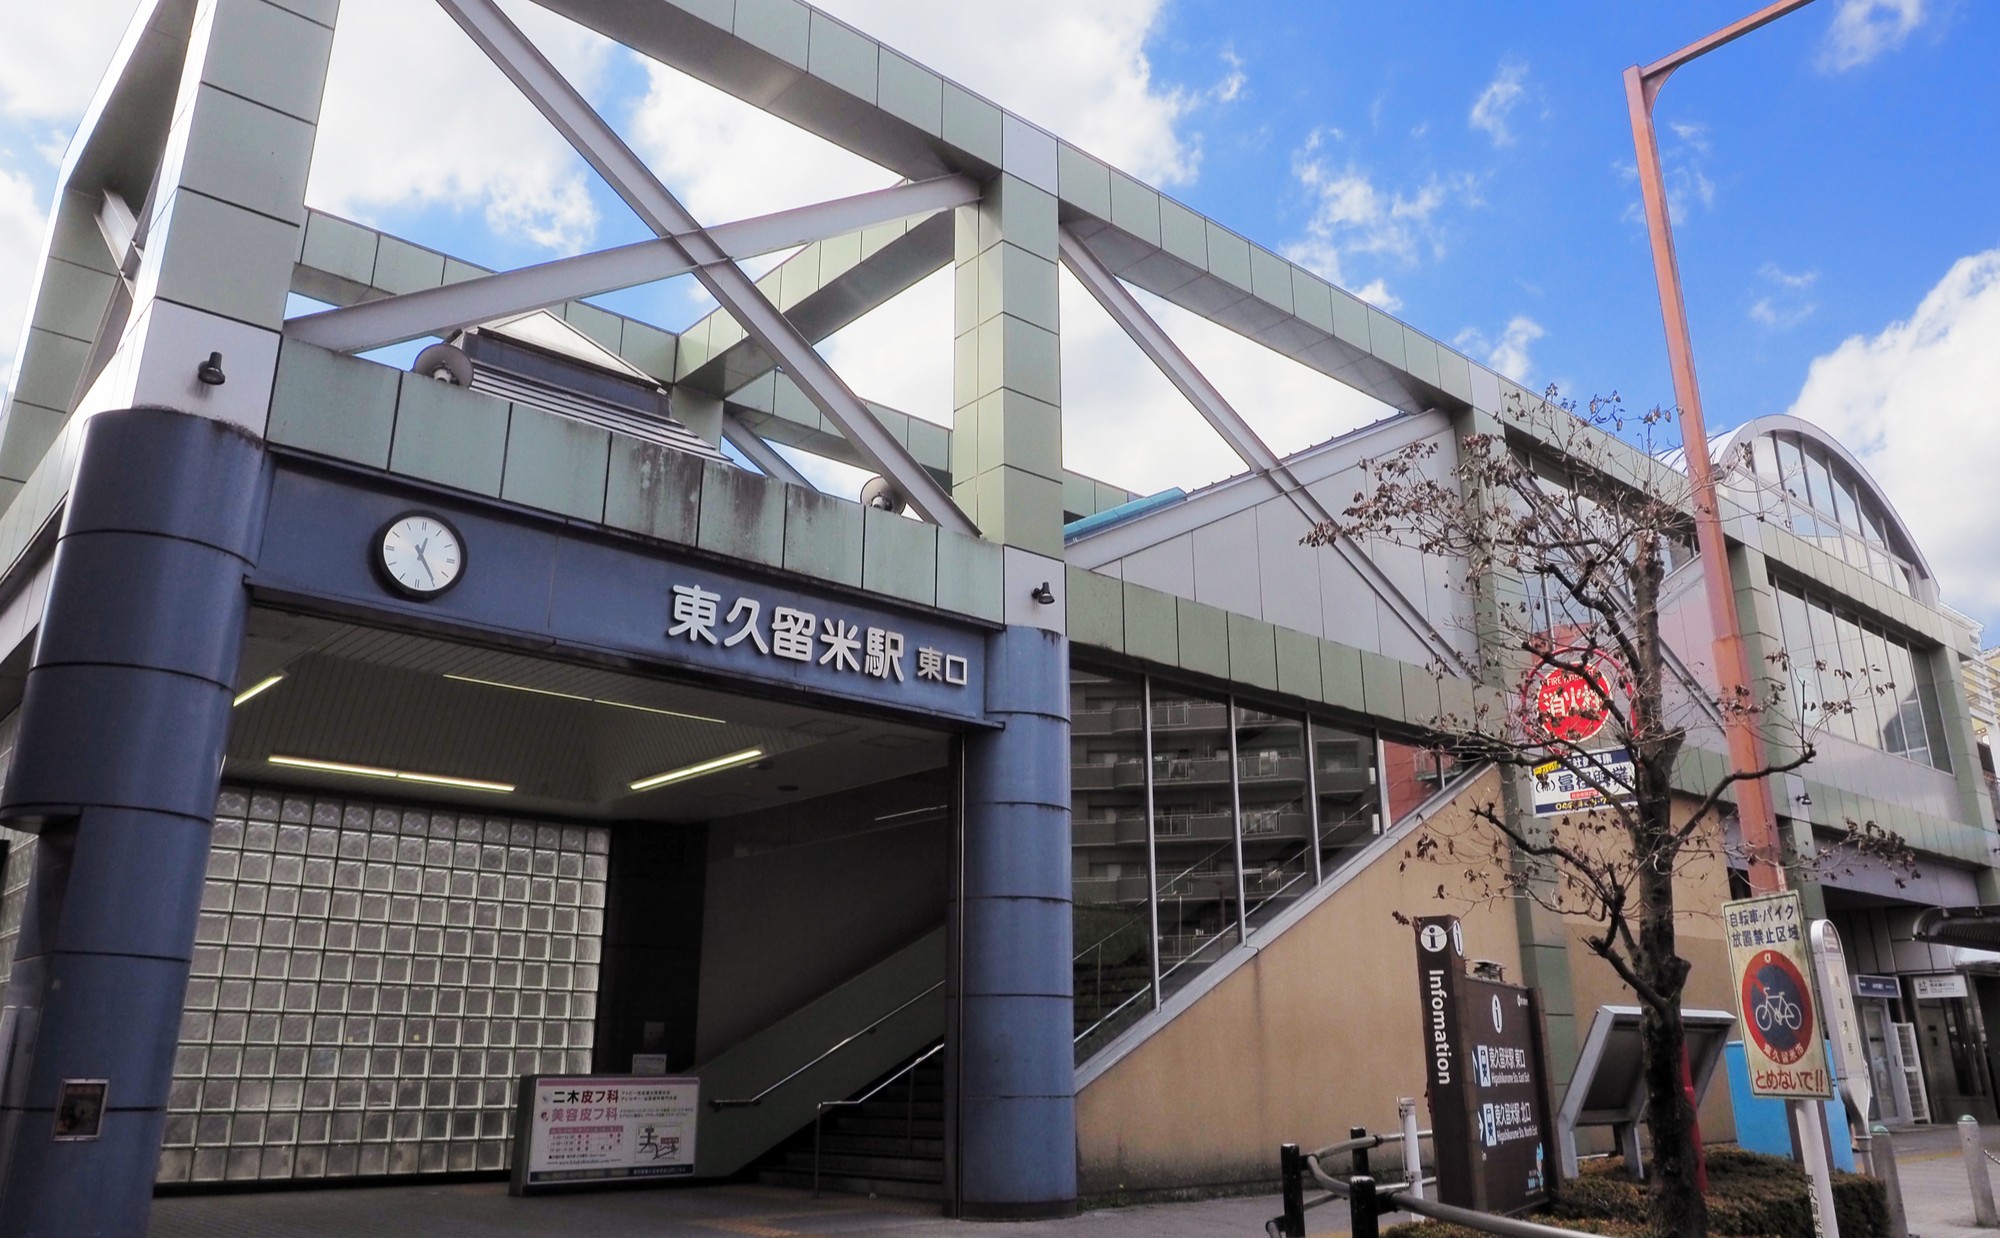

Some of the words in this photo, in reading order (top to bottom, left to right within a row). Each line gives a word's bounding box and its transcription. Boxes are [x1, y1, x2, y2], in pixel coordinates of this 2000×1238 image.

[668, 584, 905, 682] 東久留米駅
[917, 646, 968, 686] 東口
[1546, 676, 1562, 687] FIRE
[1732, 924, 1800, 948] 放置禁止区域
[1429, 969, 1452, 1085] Infomation
[1489, 1046, 1515, 1069] 東久留米駅
[1515, 1048, 1526, 1069] 東口
[1755, 1069, 1824, 1092] とめないで!!
[553, 1089, 619, 1104] 二木皮フ科
[551, 1107, 617, 1122] 美容皮フ科
[1495, 1102, 1521, 1126] 東久留米駅
